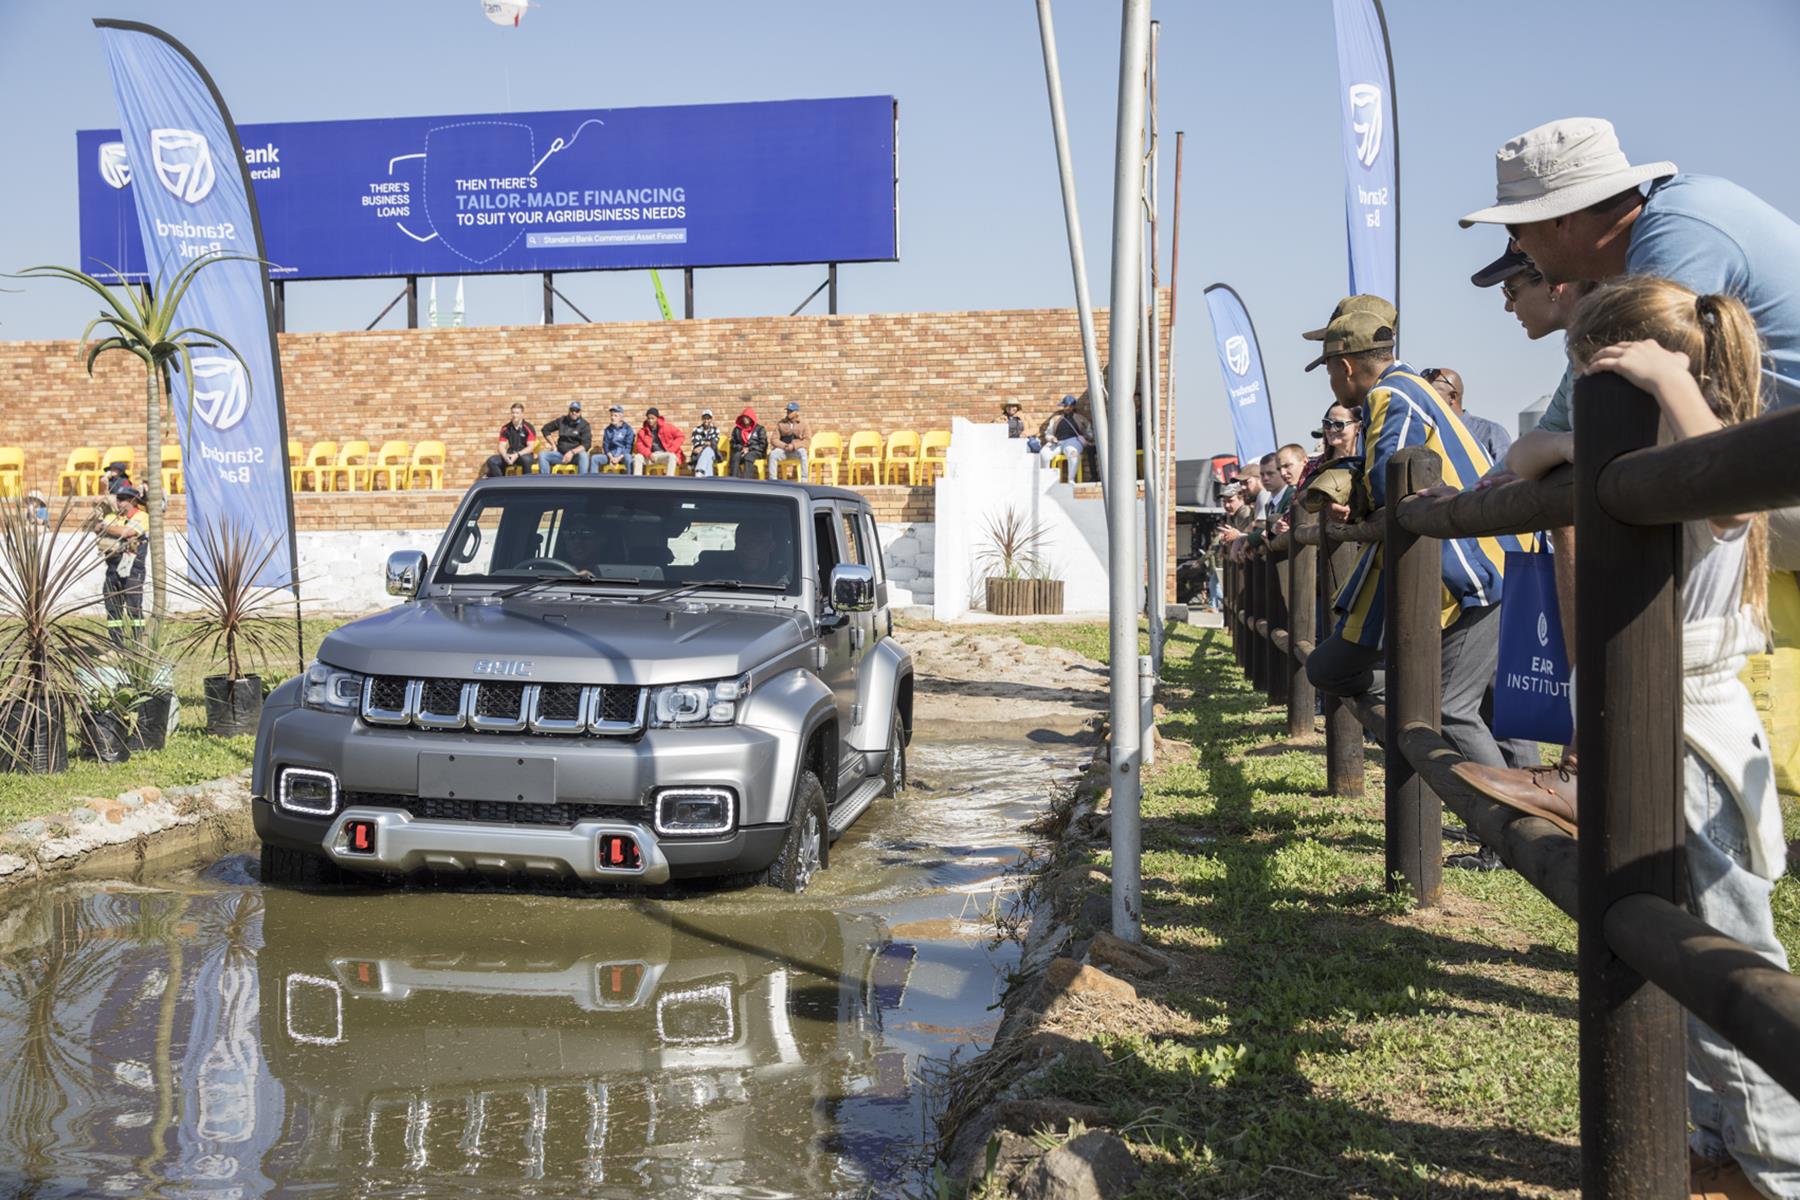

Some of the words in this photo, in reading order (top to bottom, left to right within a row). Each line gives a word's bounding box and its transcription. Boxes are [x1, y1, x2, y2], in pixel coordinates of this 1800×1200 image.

[242, 143, 280, 163] ank
[250, 167, 280, 180] ercial
[370, 182, 410, 194] THERE'S
[456, 179, 487, 191] THEN
[489, 177, 538, 190] THERE'S
[362, 194, 410, 206] BUSINESS
[456, 191, 579, 210] TAILOR-MADE
[584, 187, 685, 206] FINANCING
[377, 206, 410, 217] LOANS
[456, 213, 474, 226] TO
[477, 212, 505, 225] SUIT
[508, 211, 543, 224] YOUR
[546, 207, 640, 223] AGRIBUSINESS
[643, 206, 686, 219] NEEDS
[544, 236, 575, 244] Standard
[576, 235, 593, 243] Bank
[594, 233, 635, 242] Commercial
[636, 233, 656, 241] Asset
[657, 232, 683, 241] Finance
[474, 659, 535, 676] BAIC
[1531, 656, 1554, 675] EAR
[1507, 673, 1570, 697] INSTITUT
